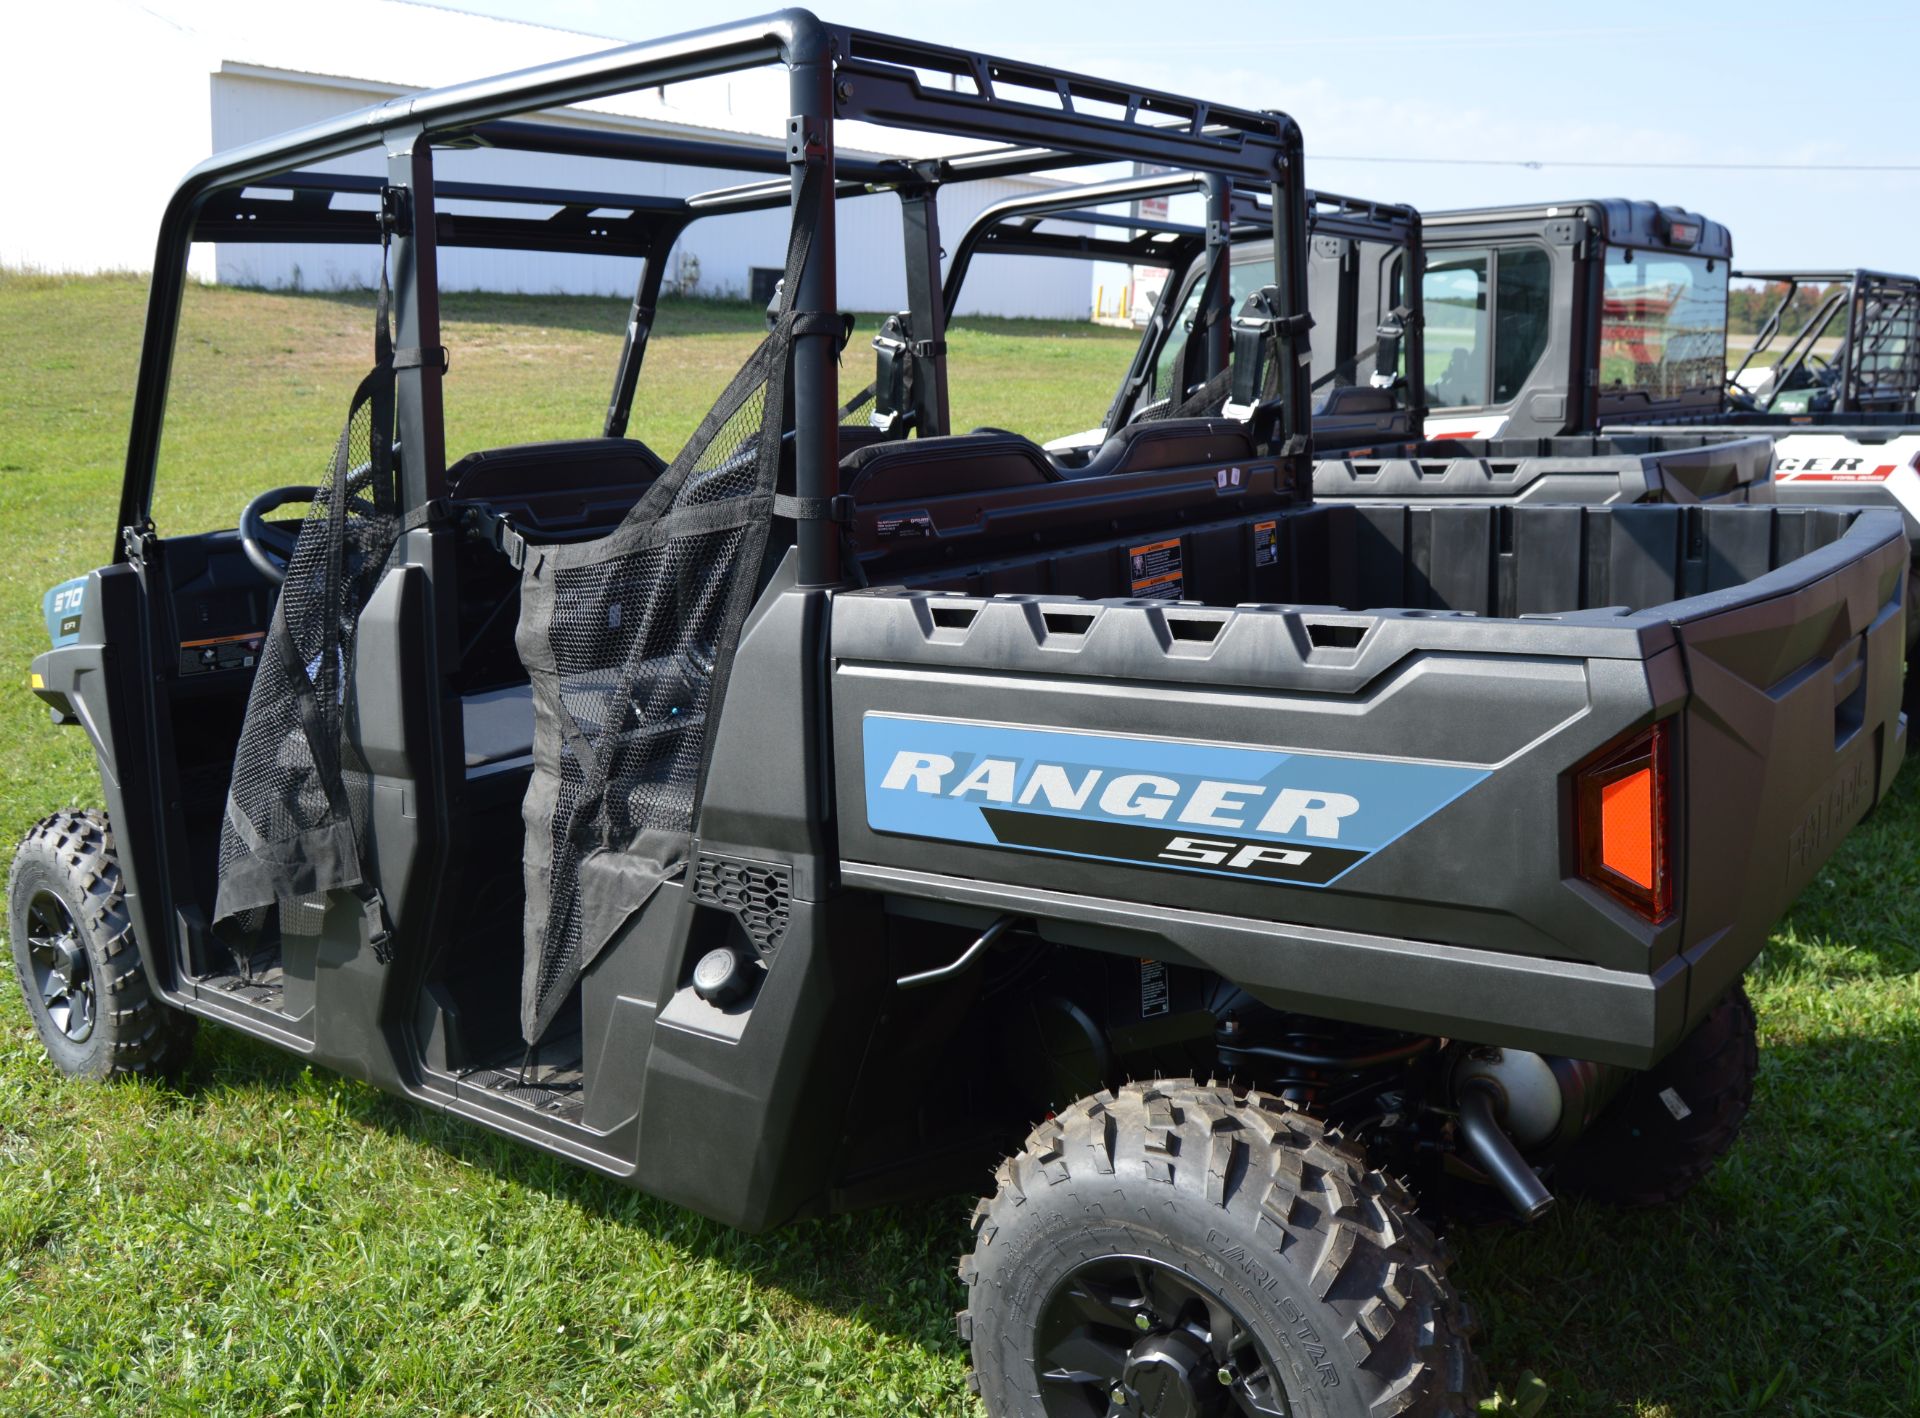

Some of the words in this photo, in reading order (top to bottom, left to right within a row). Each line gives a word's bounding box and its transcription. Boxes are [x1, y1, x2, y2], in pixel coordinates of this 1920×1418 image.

[1776, 457, 1864, 471] GER
[54, 587, 83, 613] 570
[880, 751, 1360, 839] RANGER
[1158, 837, 1312, 869] SP
[1206, 1228, 1341, 1388] CARLSTAR
